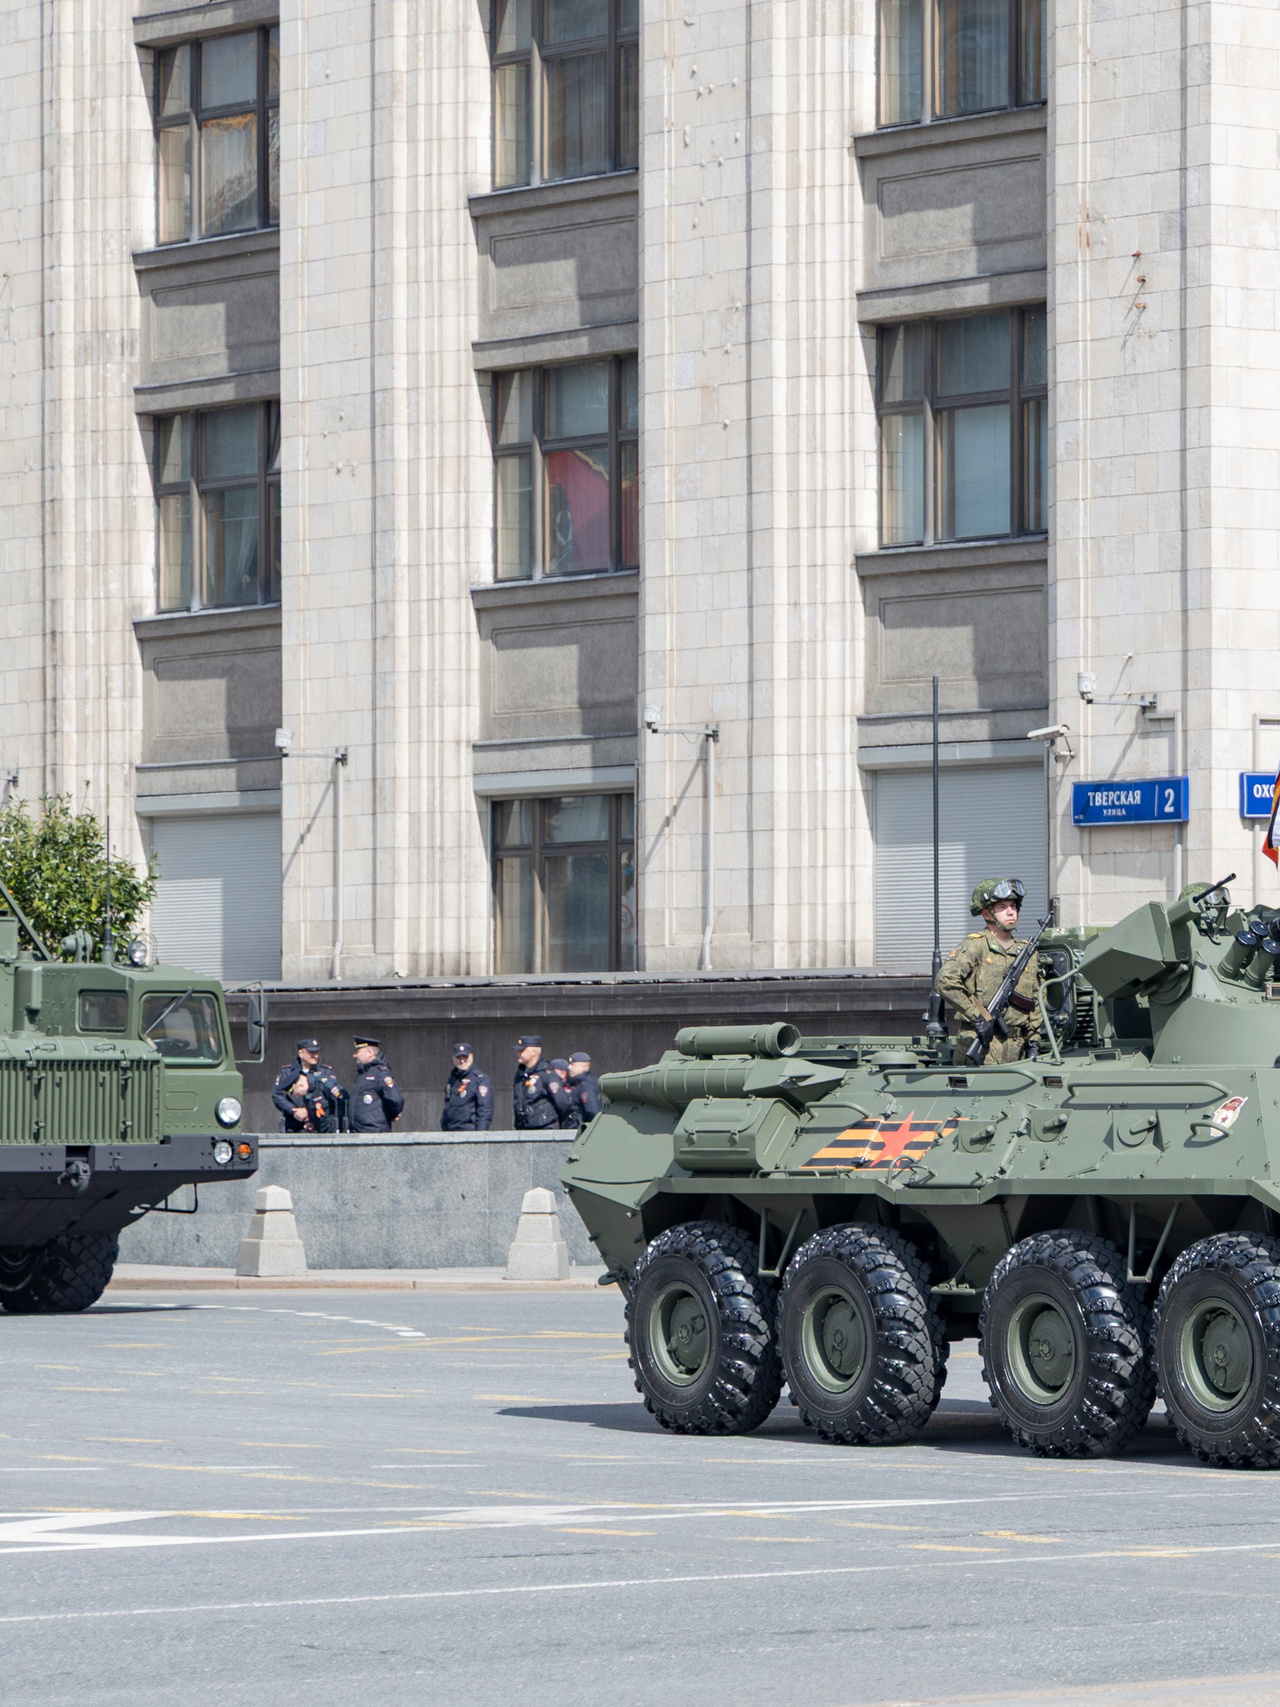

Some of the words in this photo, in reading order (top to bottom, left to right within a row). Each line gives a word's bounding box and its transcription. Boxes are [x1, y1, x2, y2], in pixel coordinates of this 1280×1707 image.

[1088, 790, 1141, 806] ТВЕРСКАЯ
[1164, 788, 1175, 813] 2
[1103, 808, 1126, 817] УЛИЦА
